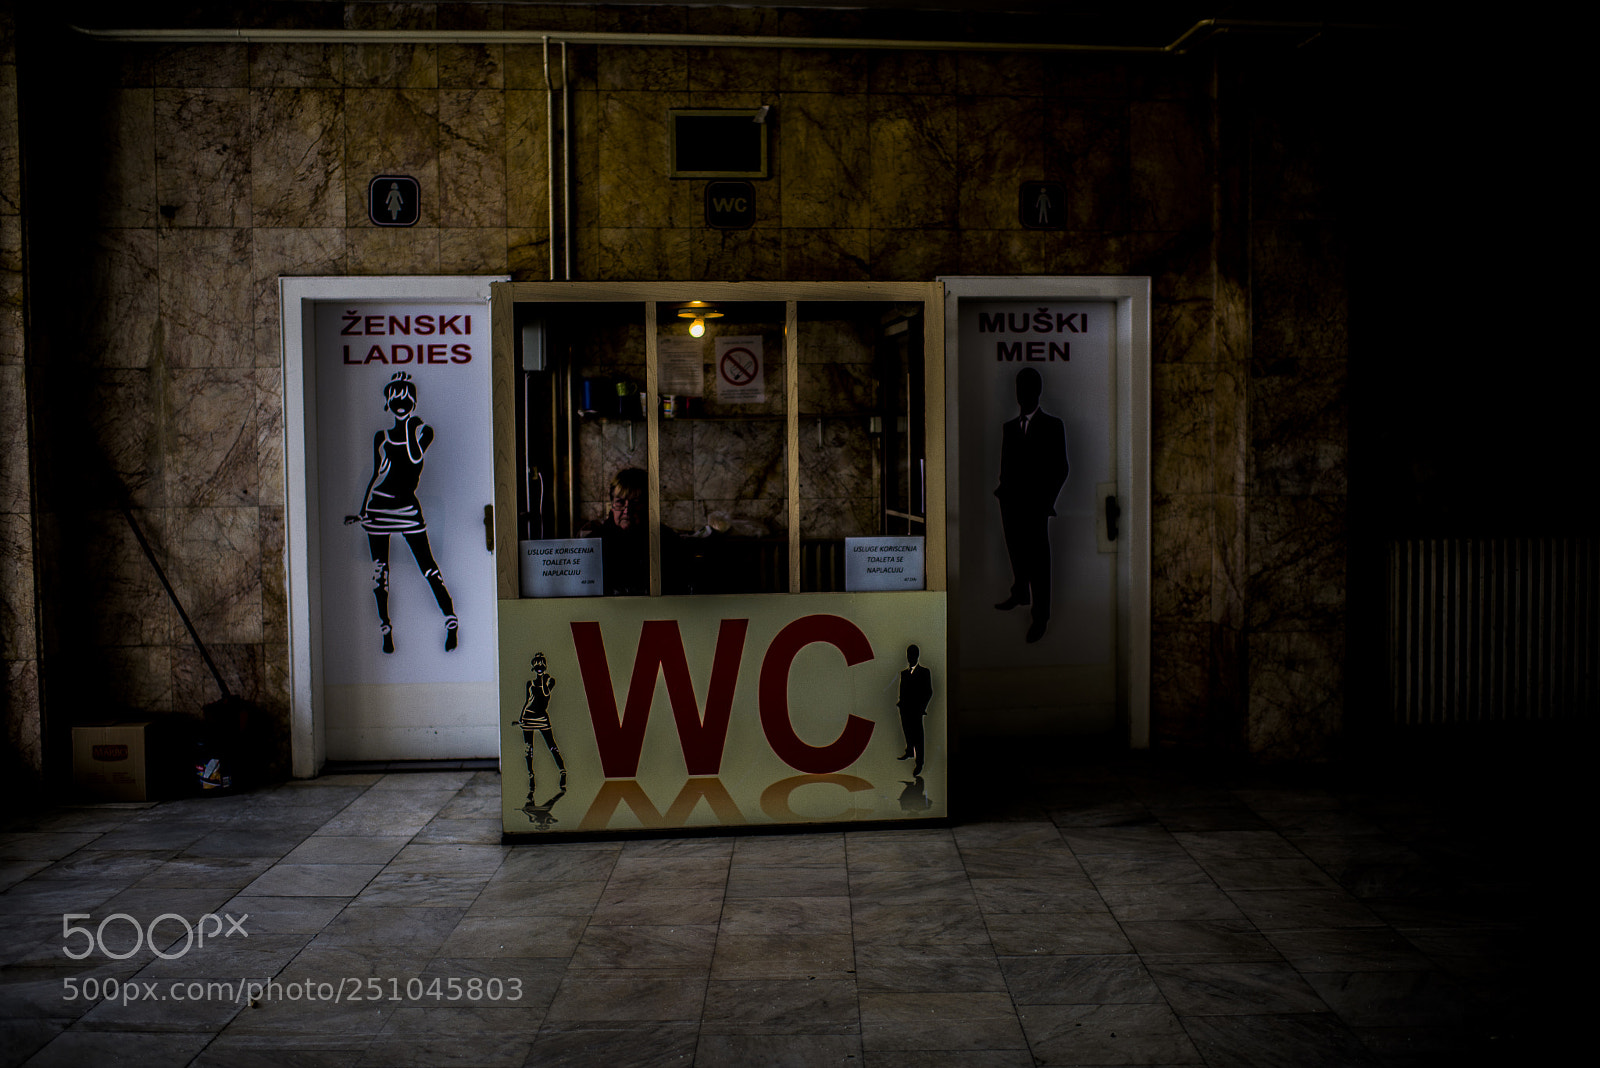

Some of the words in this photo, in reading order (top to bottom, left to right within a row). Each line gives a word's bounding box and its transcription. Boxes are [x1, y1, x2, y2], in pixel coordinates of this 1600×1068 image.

[712, 197, 748, 213] WC
[341, 310, 472, 336] ŽENSKI
[979, 307, 1088, 333] MUŠKI
[343, 344, 472, 365] LADIES
[997, 341, 1070, 362] MEN
[527, 548, 554, 556] USLUGE
[570, 614, 876, 778] WC
